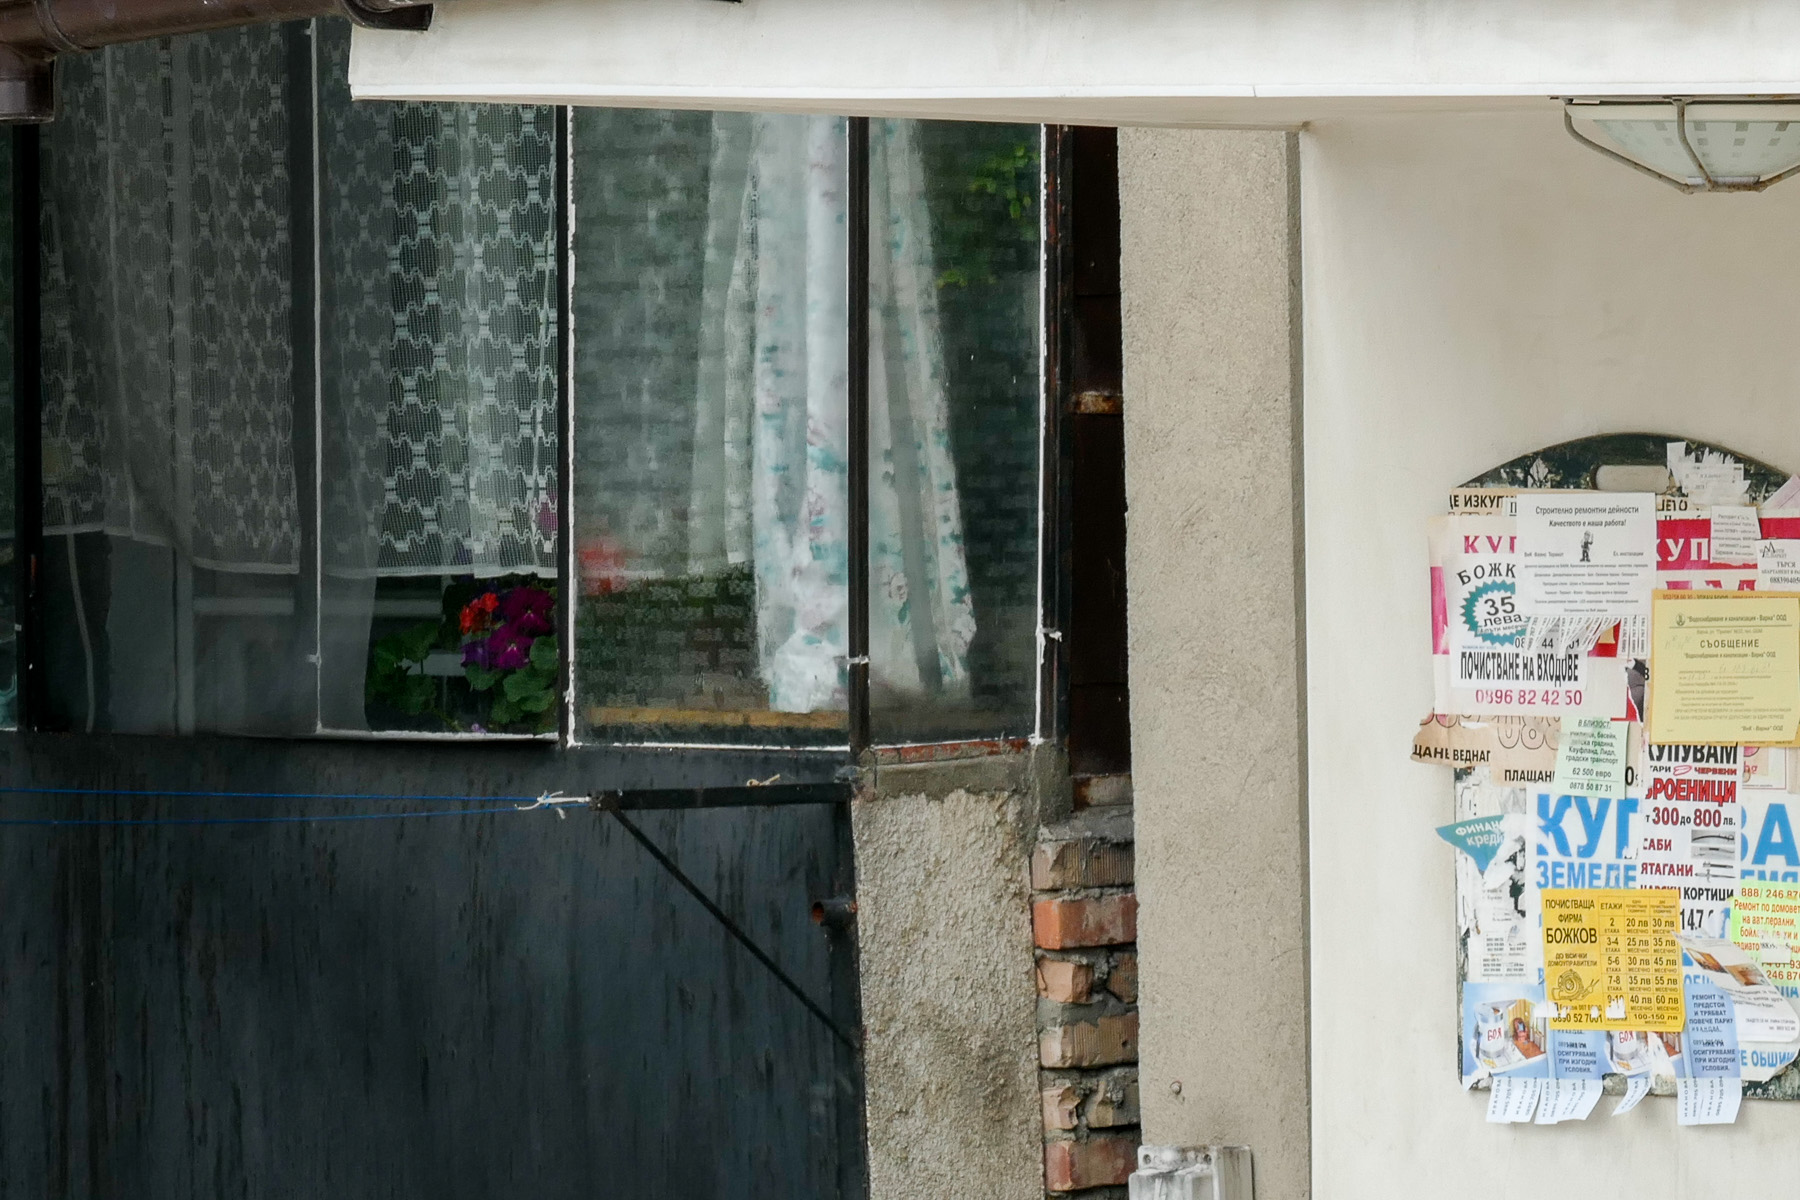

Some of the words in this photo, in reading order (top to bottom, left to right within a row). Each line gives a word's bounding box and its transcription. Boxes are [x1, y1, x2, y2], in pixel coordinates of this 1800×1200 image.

[1536, 506, 1572, 516] Строително
[1574, 507, 1607, 516] ремонтни
[1608, 505, 1639, 515] дейности
[1549, 520, 1581, 528] Качеството
[1604, 519, 1627, 528] работа!
[1484, 596, 1516, 616] 35
[1483, 614, 1522, 628] лева
[1700, 639, 1760, 649] СЪОБЩЕНИЕ
[1460, 651, 1520, 681] ПОЧИСТВАНЕ
[1522, 654, 1535, 681] НА
[1518, 690, 1536, 706] 82
[1541, 689, 1559, 706] 42
[1565, 689, 1583, 706] 50
[1590, 756, 1618, 766] транспорт
[1504, 769, 1555, 783] ПЛАЩАН
[1572, 767, 1581, 775] 62
[1582, 768, 1594, 776] 500
[1595, 770, 1611, 779] евро
[1694, 766, 1737, 776] ЧЕРВЕНИ
[1586, 783, 1594, 791] 50
[1604, 784, 1612, 792] 31
[1645, 778, 1736, 807] РОЕНИЦИ
[1652, 807, 1679, 826] 300
[1679, 817, 1691, 827] до
[1693, 808, 1721, 828] 800
[1722, 817, 1735, 827] лв.
[1641, 862, 1693, 877] ЯТАГАНИ
[1683, 887, 1734, 902] КОРТИЦИ
[1766, 889, 1784, 899] 246
[1546, 899, 1595, 910] ПОЧИСТВАЩА
[1600, 902, 1623, 910] ЕТАЖИ
[1734, 899, 1760, 911] Ремонт
[1761, 903, 1769, 912] по
[1558, 913, 1583, 924] ФИРМА
[1609, 917, 1615, 927] 2
[1626, 918, 1636, 927] 20
[1637, 920, 1649, 928] лв
[1652, 918, 1662, 927] 30
[1664, 920, 1675, 928] лв
[1742, 915, 1750, 924] на
[1546, 927, 1598, 944] БОЖКОВ
[1607, 937, 1619, 946] 3-4
[1627, 937, 1637, 946] 25
[1638, 939, 1649, 947] лв
[1653, 937, 1663, 946] 35
[1665, 939, 1676, 947] лв
[1555, 952, 1564, 960] ДО
[1607, 956, 1620, 966] 5-6
[1628, 957, 1638, 966] 30
[1639, 958, 1650, 966] лв
[1653, 957, 1664, 966] 45
[1666, 958, 1677, 966] лв
[1766, 970, 1784, 980] 246
[1608, 976, 1621, 985] 7-8
[1629, 976, 1639, 985] 35
[1654, 976, 1665, 985] 55
[1667, 978, 1678, 986] лв
[1630, 995, 1640, 1004] 40
[1656, 995, 1666, 1004] 60
[1668, 997, 1679, 1005] лв
[1573, 1013, 1582, 1023] 52
[1557, 1050, 1596, 1058] ОСИГУРЯВАМЕ
